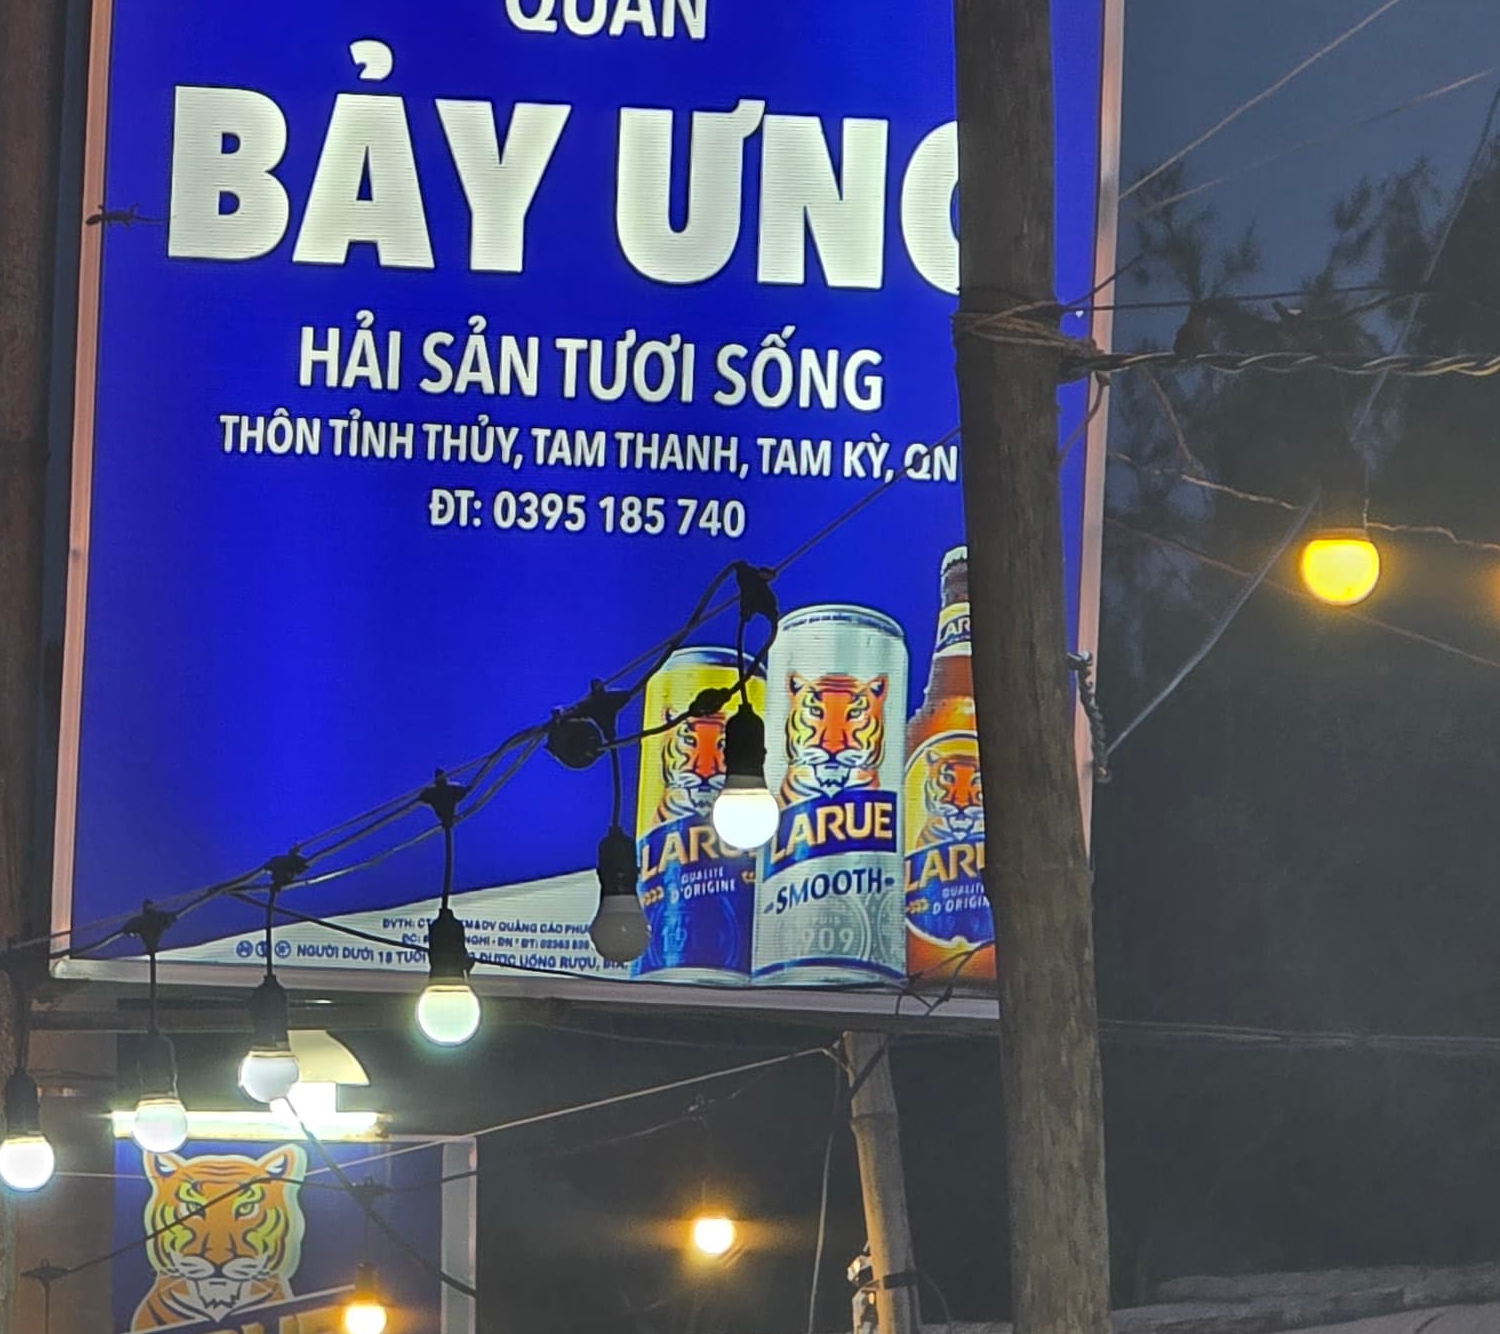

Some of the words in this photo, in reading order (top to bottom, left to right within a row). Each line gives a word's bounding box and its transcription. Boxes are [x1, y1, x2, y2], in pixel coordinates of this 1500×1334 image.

[168, 39, 572, 273] BẢY
[300, 310, 401, 390] HẢI
[419, 315, 539, 397] SẢN
[555, 329, 695, 403] TƯƠI
[713, 325, 883, 411] SỐNG
[220, 407, 320, 455] THÔN
[329, 408, 414, 459] TỈNH
[422, 414, 521, 468] THỦY,
[531, 428, 605, 468] TAM
[614, 431, 749, 479] THANH,
[757, 438, 831, 476] TAM
[844, 432, 894, 483] KỲ,
[904, 443, 958, 482] QN
[429, 489, 482, 527] ĐT:
[494, 491, 586, 531] 0395
[599, 496, 665, 534] 185
[676, 499, 746, 538] 740
[641, 825, 757, 880] LAR
[770, 802, 893, 865] LARUE
[776, 867, 882, 915] SMOOTH
[904, 841, 985, 893] LAR
[378, 951, 393, 964] 18
